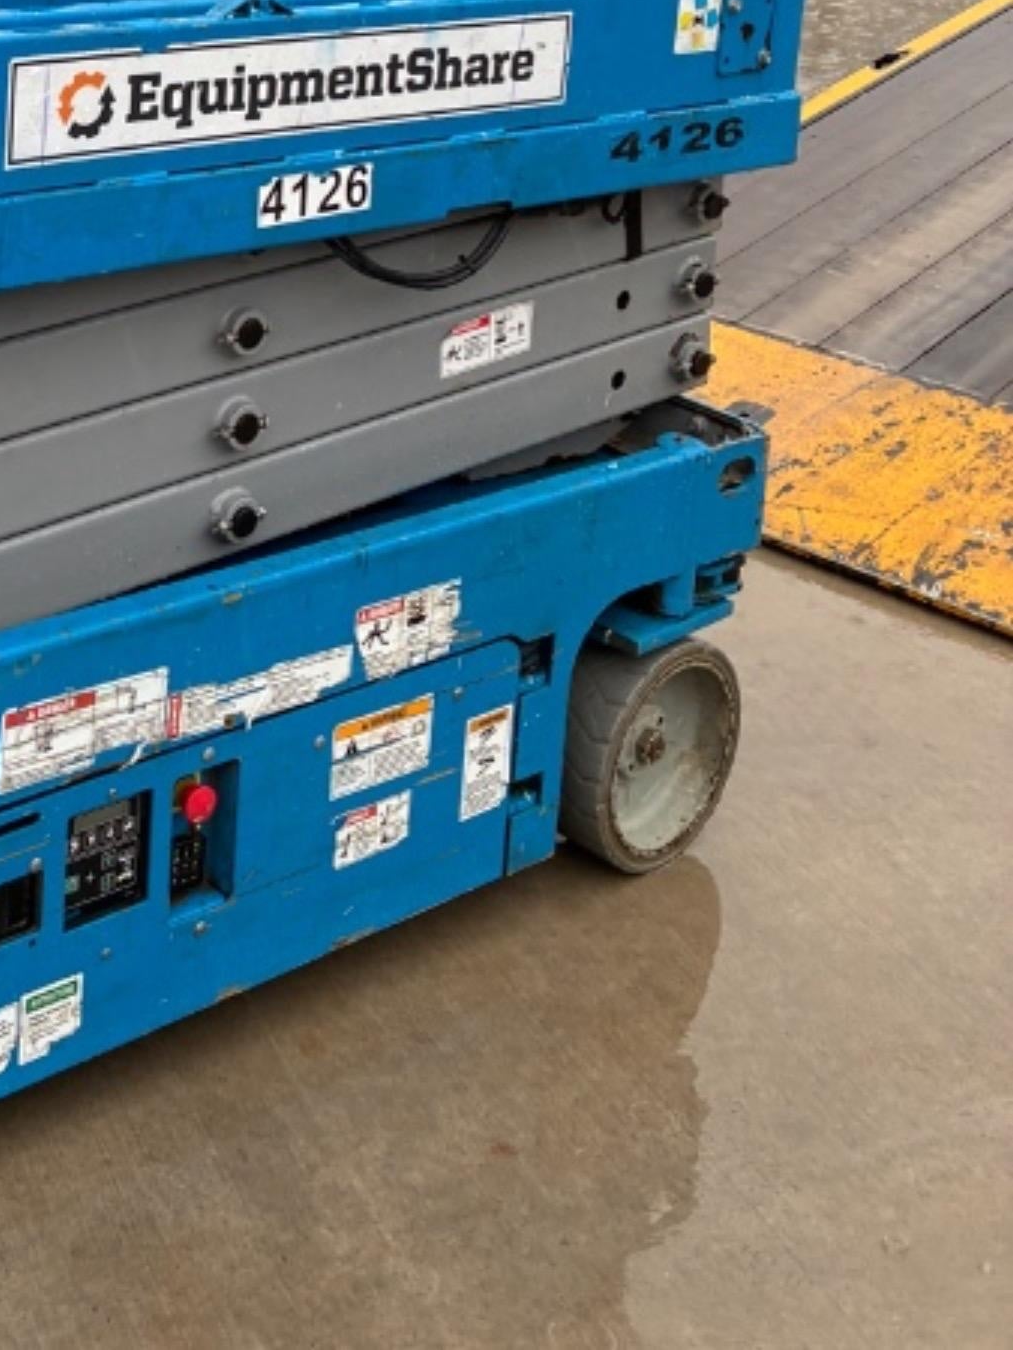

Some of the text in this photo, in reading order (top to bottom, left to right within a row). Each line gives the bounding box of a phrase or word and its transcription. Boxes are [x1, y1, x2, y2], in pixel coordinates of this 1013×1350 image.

[125, 47, 535, 129] EquipmentShare
[610, 116, 745, 163] 4126
[261, 164, 370, 223] 4126
